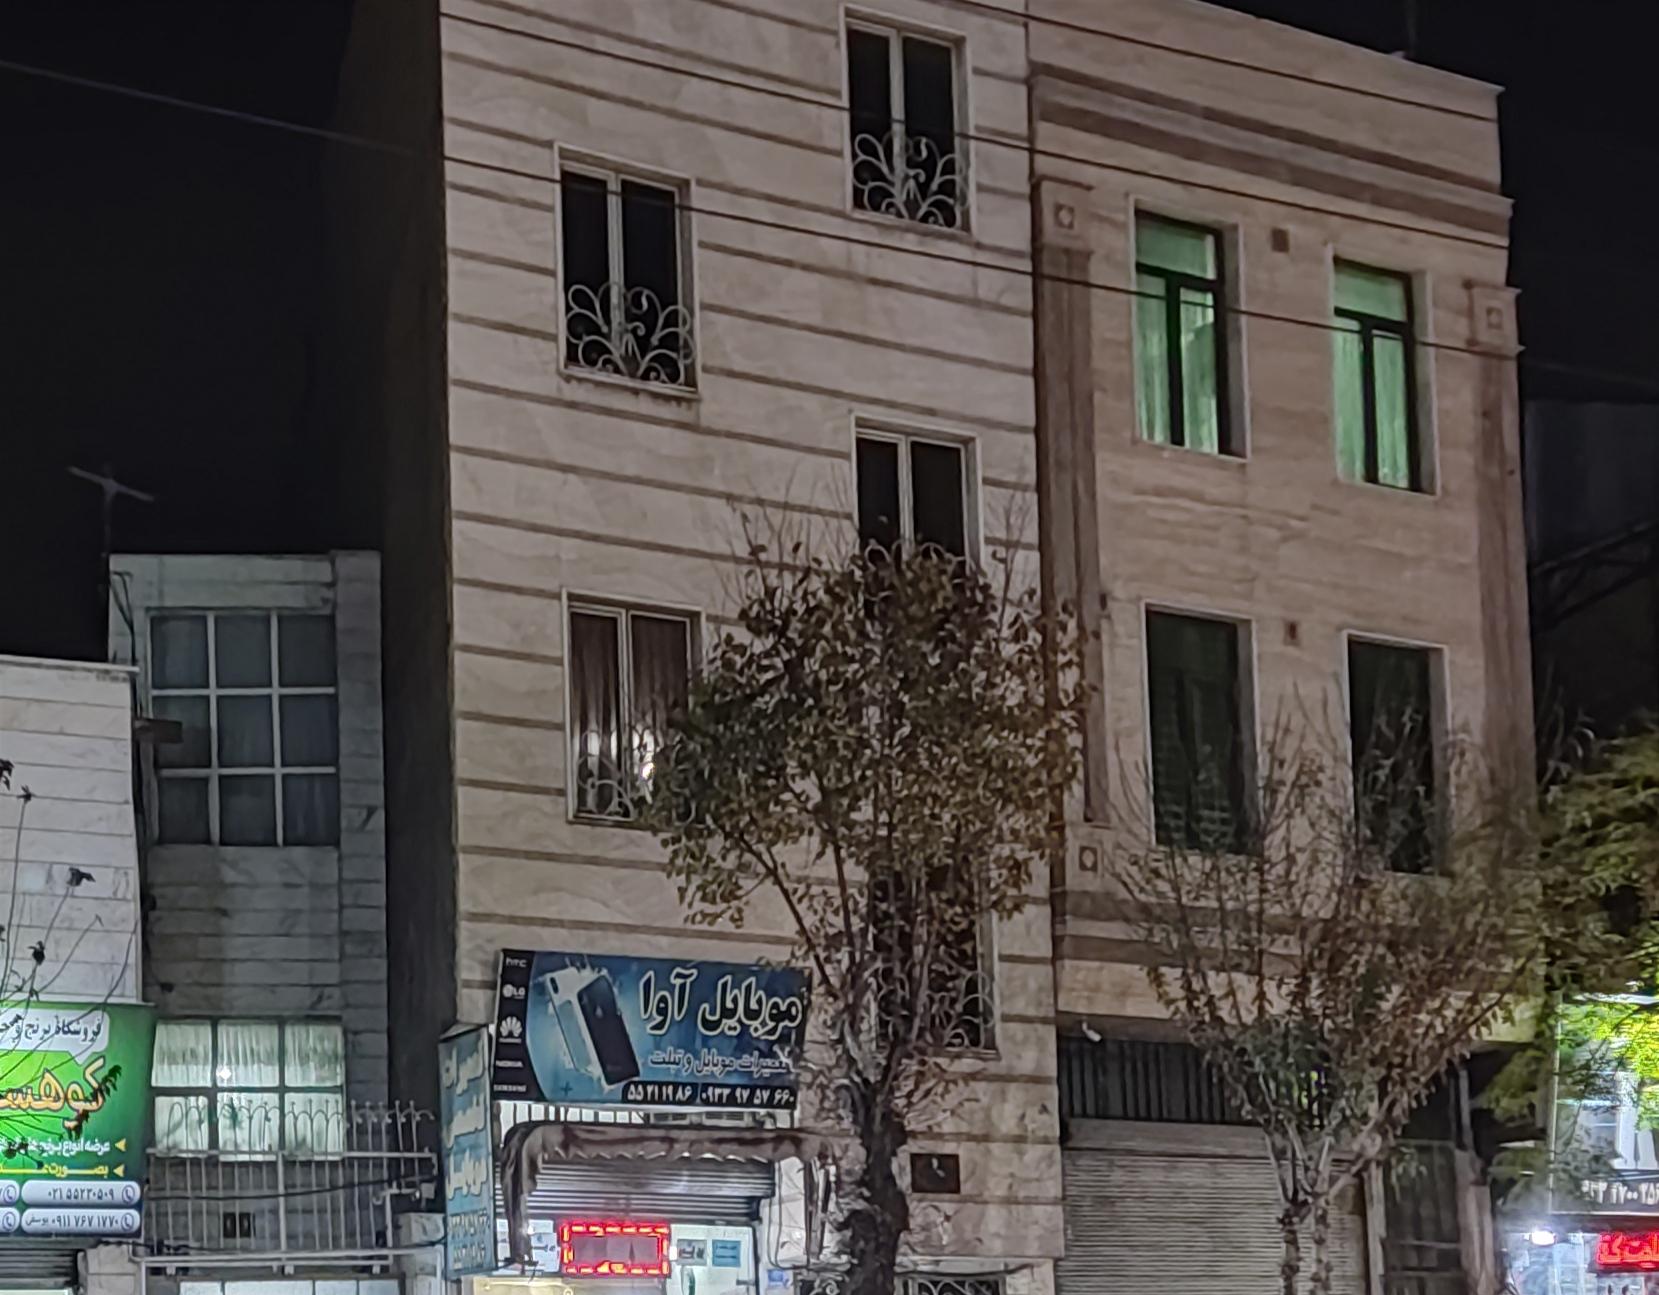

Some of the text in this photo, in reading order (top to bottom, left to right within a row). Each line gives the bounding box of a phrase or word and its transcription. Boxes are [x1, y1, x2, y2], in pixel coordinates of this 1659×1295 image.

[640, 967, 803, 1040] موبایل آوا
[650, 1047, 684, 1073] تبلت
[694, 1048, 736, 1078] موبایل
[0, 1055, 104, 1131] کوهس
